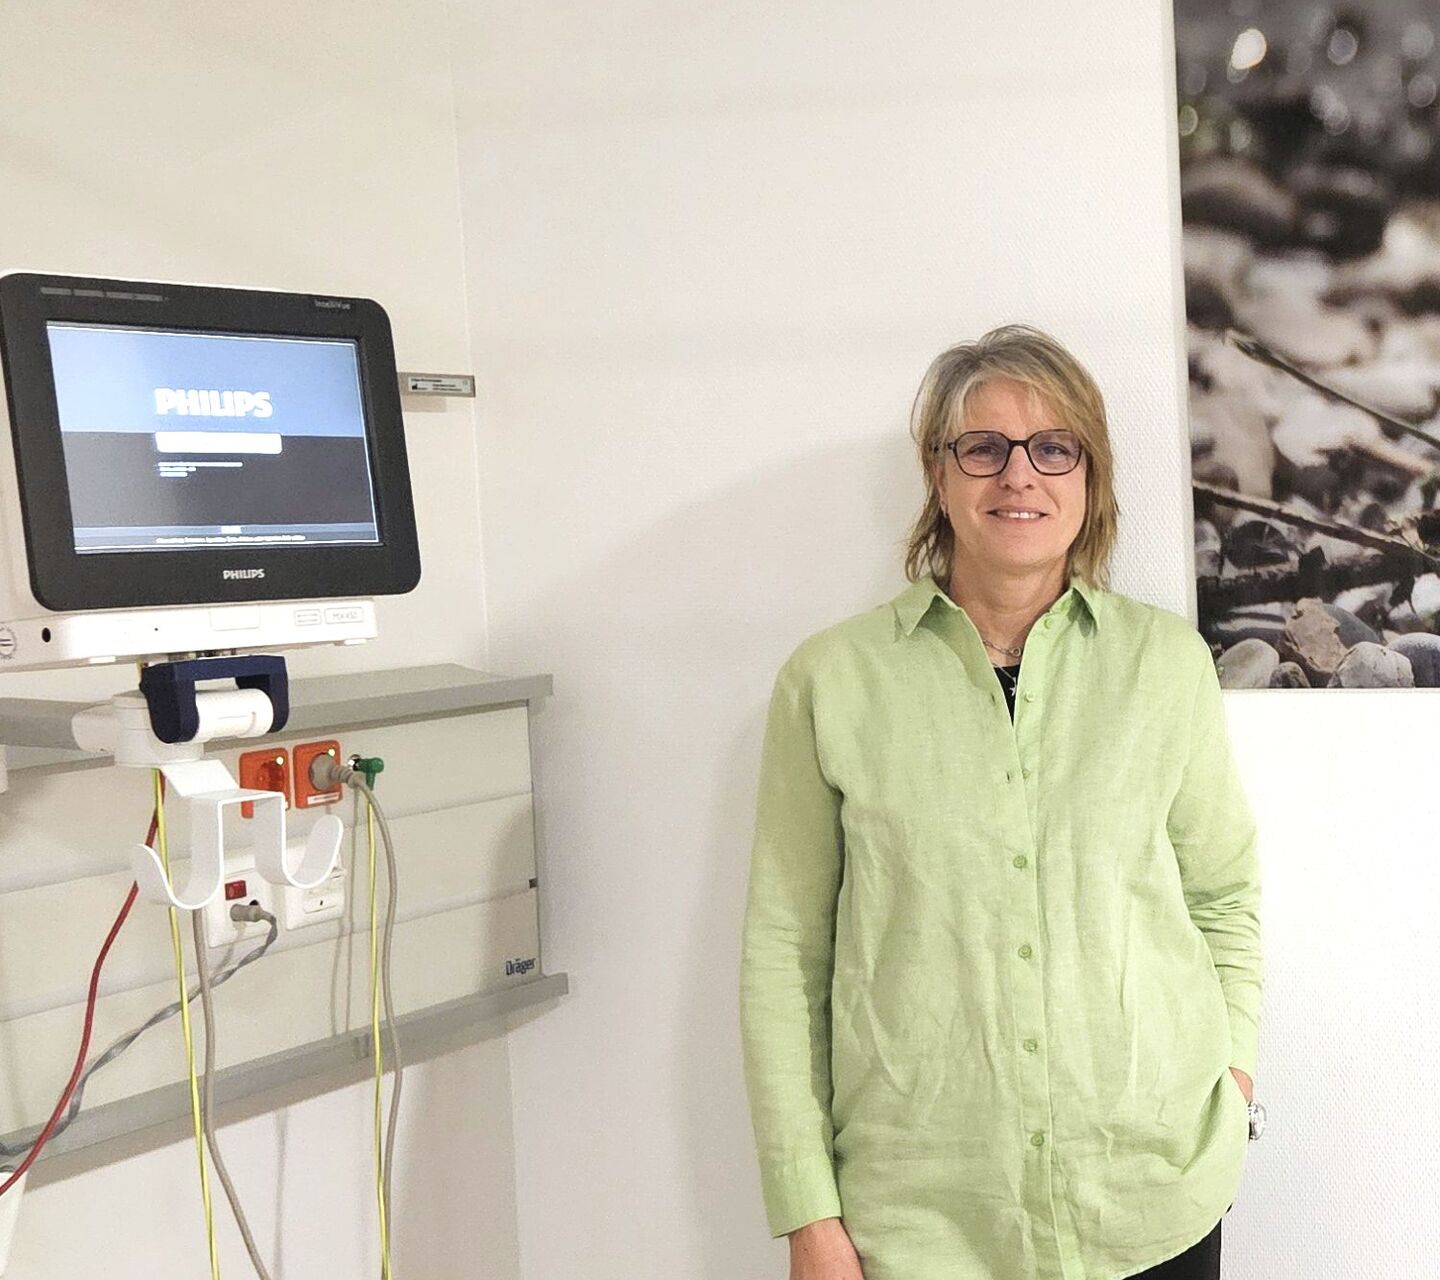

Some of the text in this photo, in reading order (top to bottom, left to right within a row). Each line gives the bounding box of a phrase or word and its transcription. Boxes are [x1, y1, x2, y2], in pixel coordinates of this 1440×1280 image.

[154, 387, 274, 418] PHILIPS
[223, 568, 266, 580] PHILIPS
[506, 957, 537, 976] Dräger
